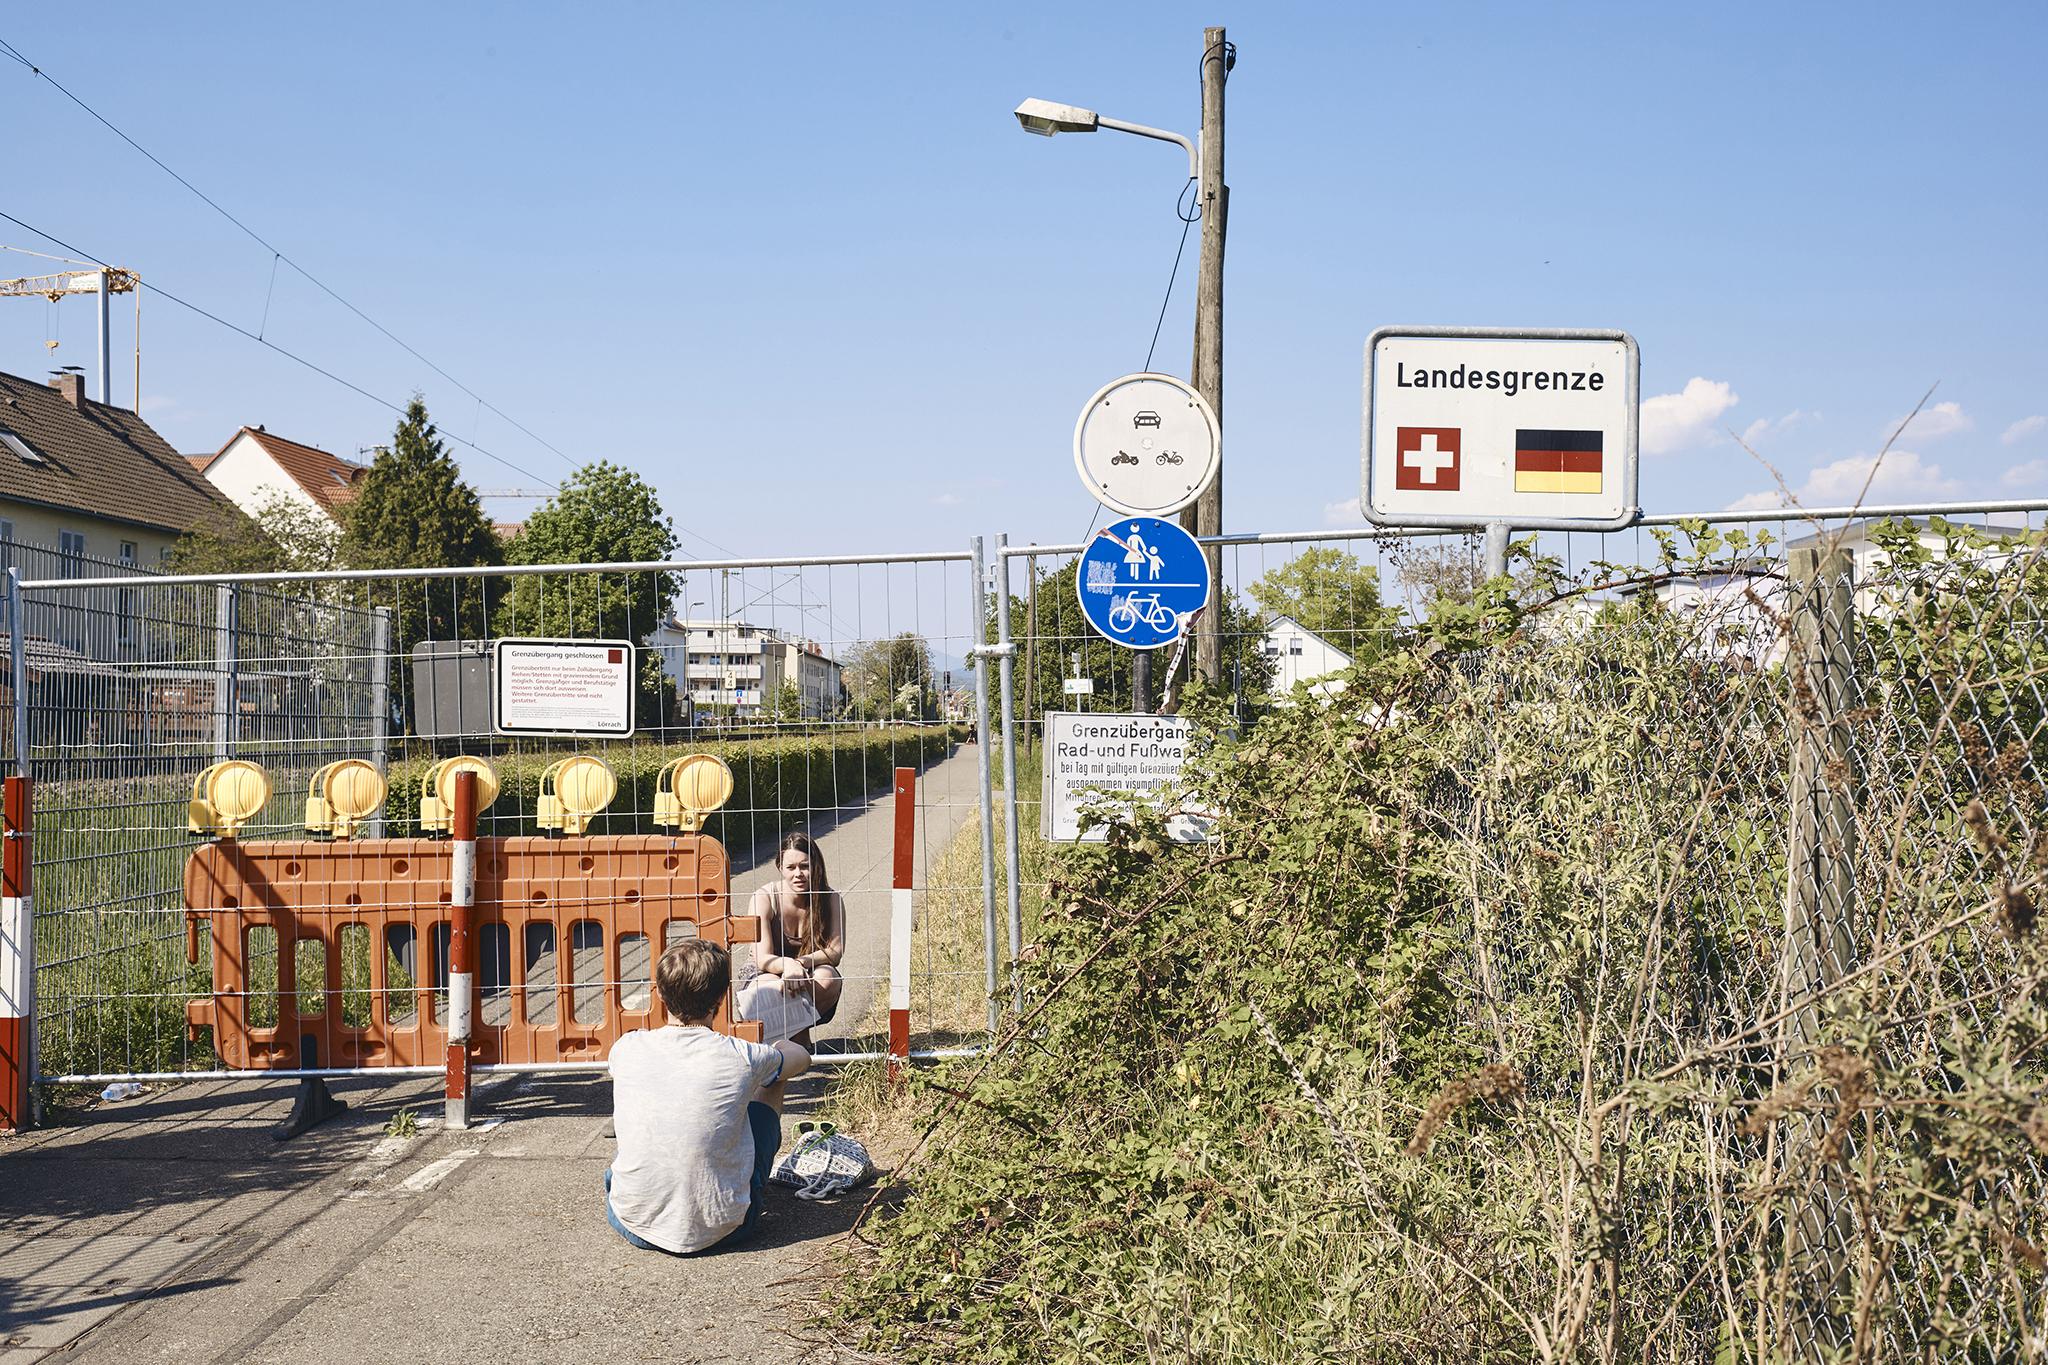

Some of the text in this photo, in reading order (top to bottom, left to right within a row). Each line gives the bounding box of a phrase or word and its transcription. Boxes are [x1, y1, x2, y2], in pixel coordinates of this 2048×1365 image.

[1397, 361, 1604, 397] Landesgrenze
[511, 650, 604, 660] Grenzübergang geschlossen
[1060, 762, 1073, 774] bei
[1075, 762, 1088, 776] Tag
[1091, 762, 1104, 774] mit
[1106, 762, 1138, 776] gültigen
